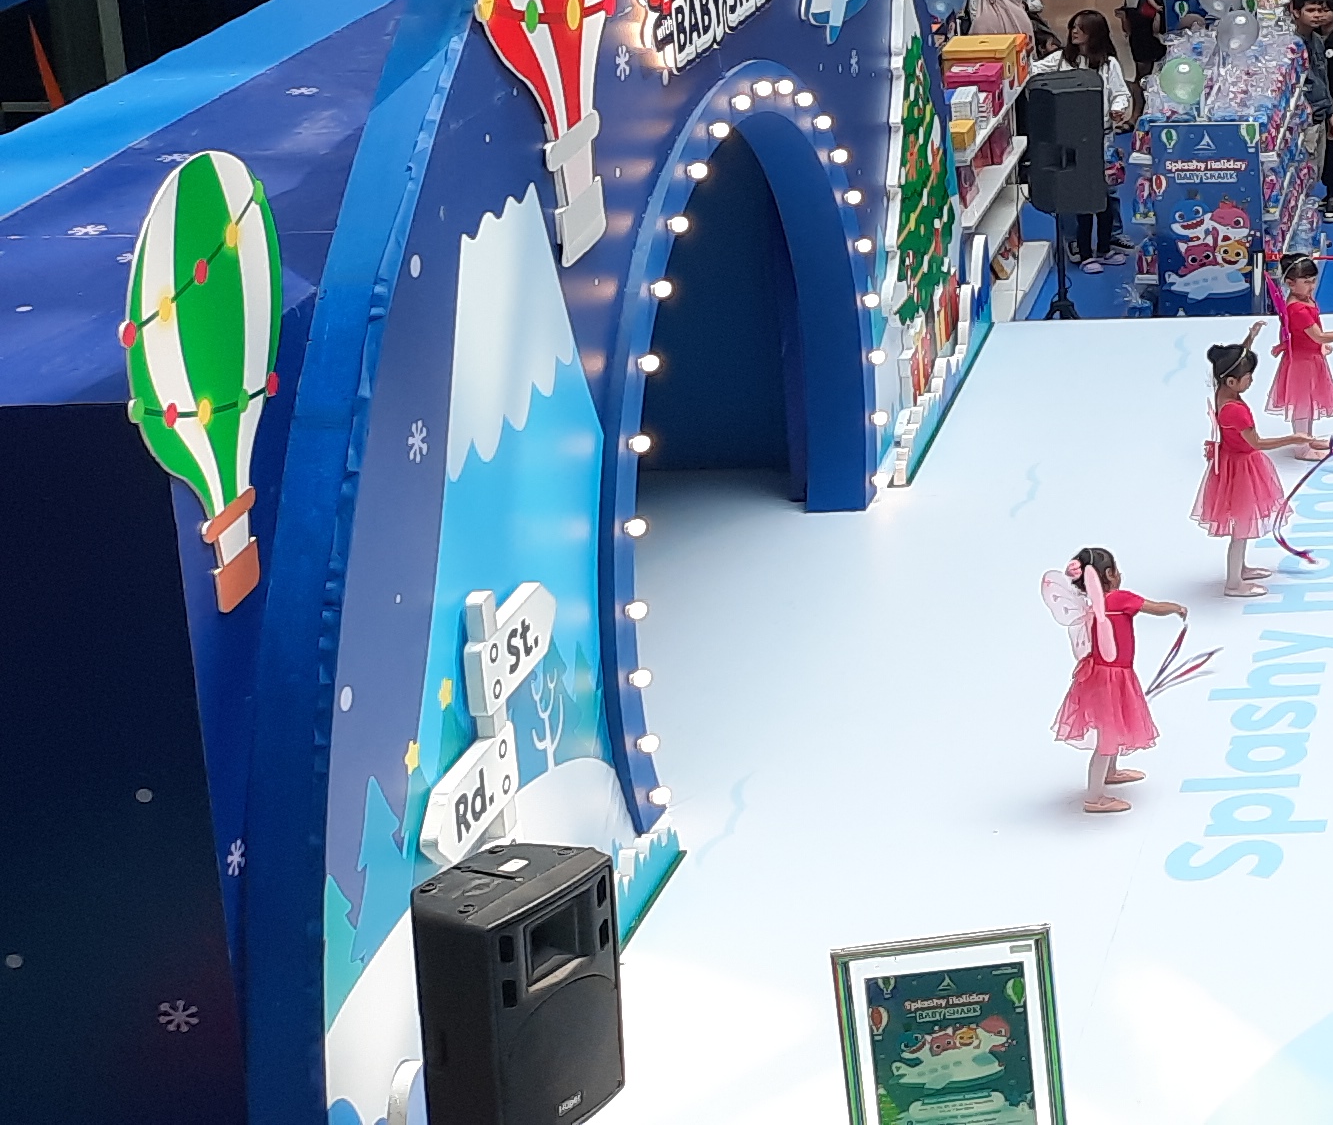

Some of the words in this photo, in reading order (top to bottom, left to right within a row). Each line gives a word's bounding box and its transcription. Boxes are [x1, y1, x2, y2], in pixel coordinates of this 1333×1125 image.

[656, 17, 674, 42] with
[506, 618, 540, 675] St.
[455, 768, 495, 844] Rd.
